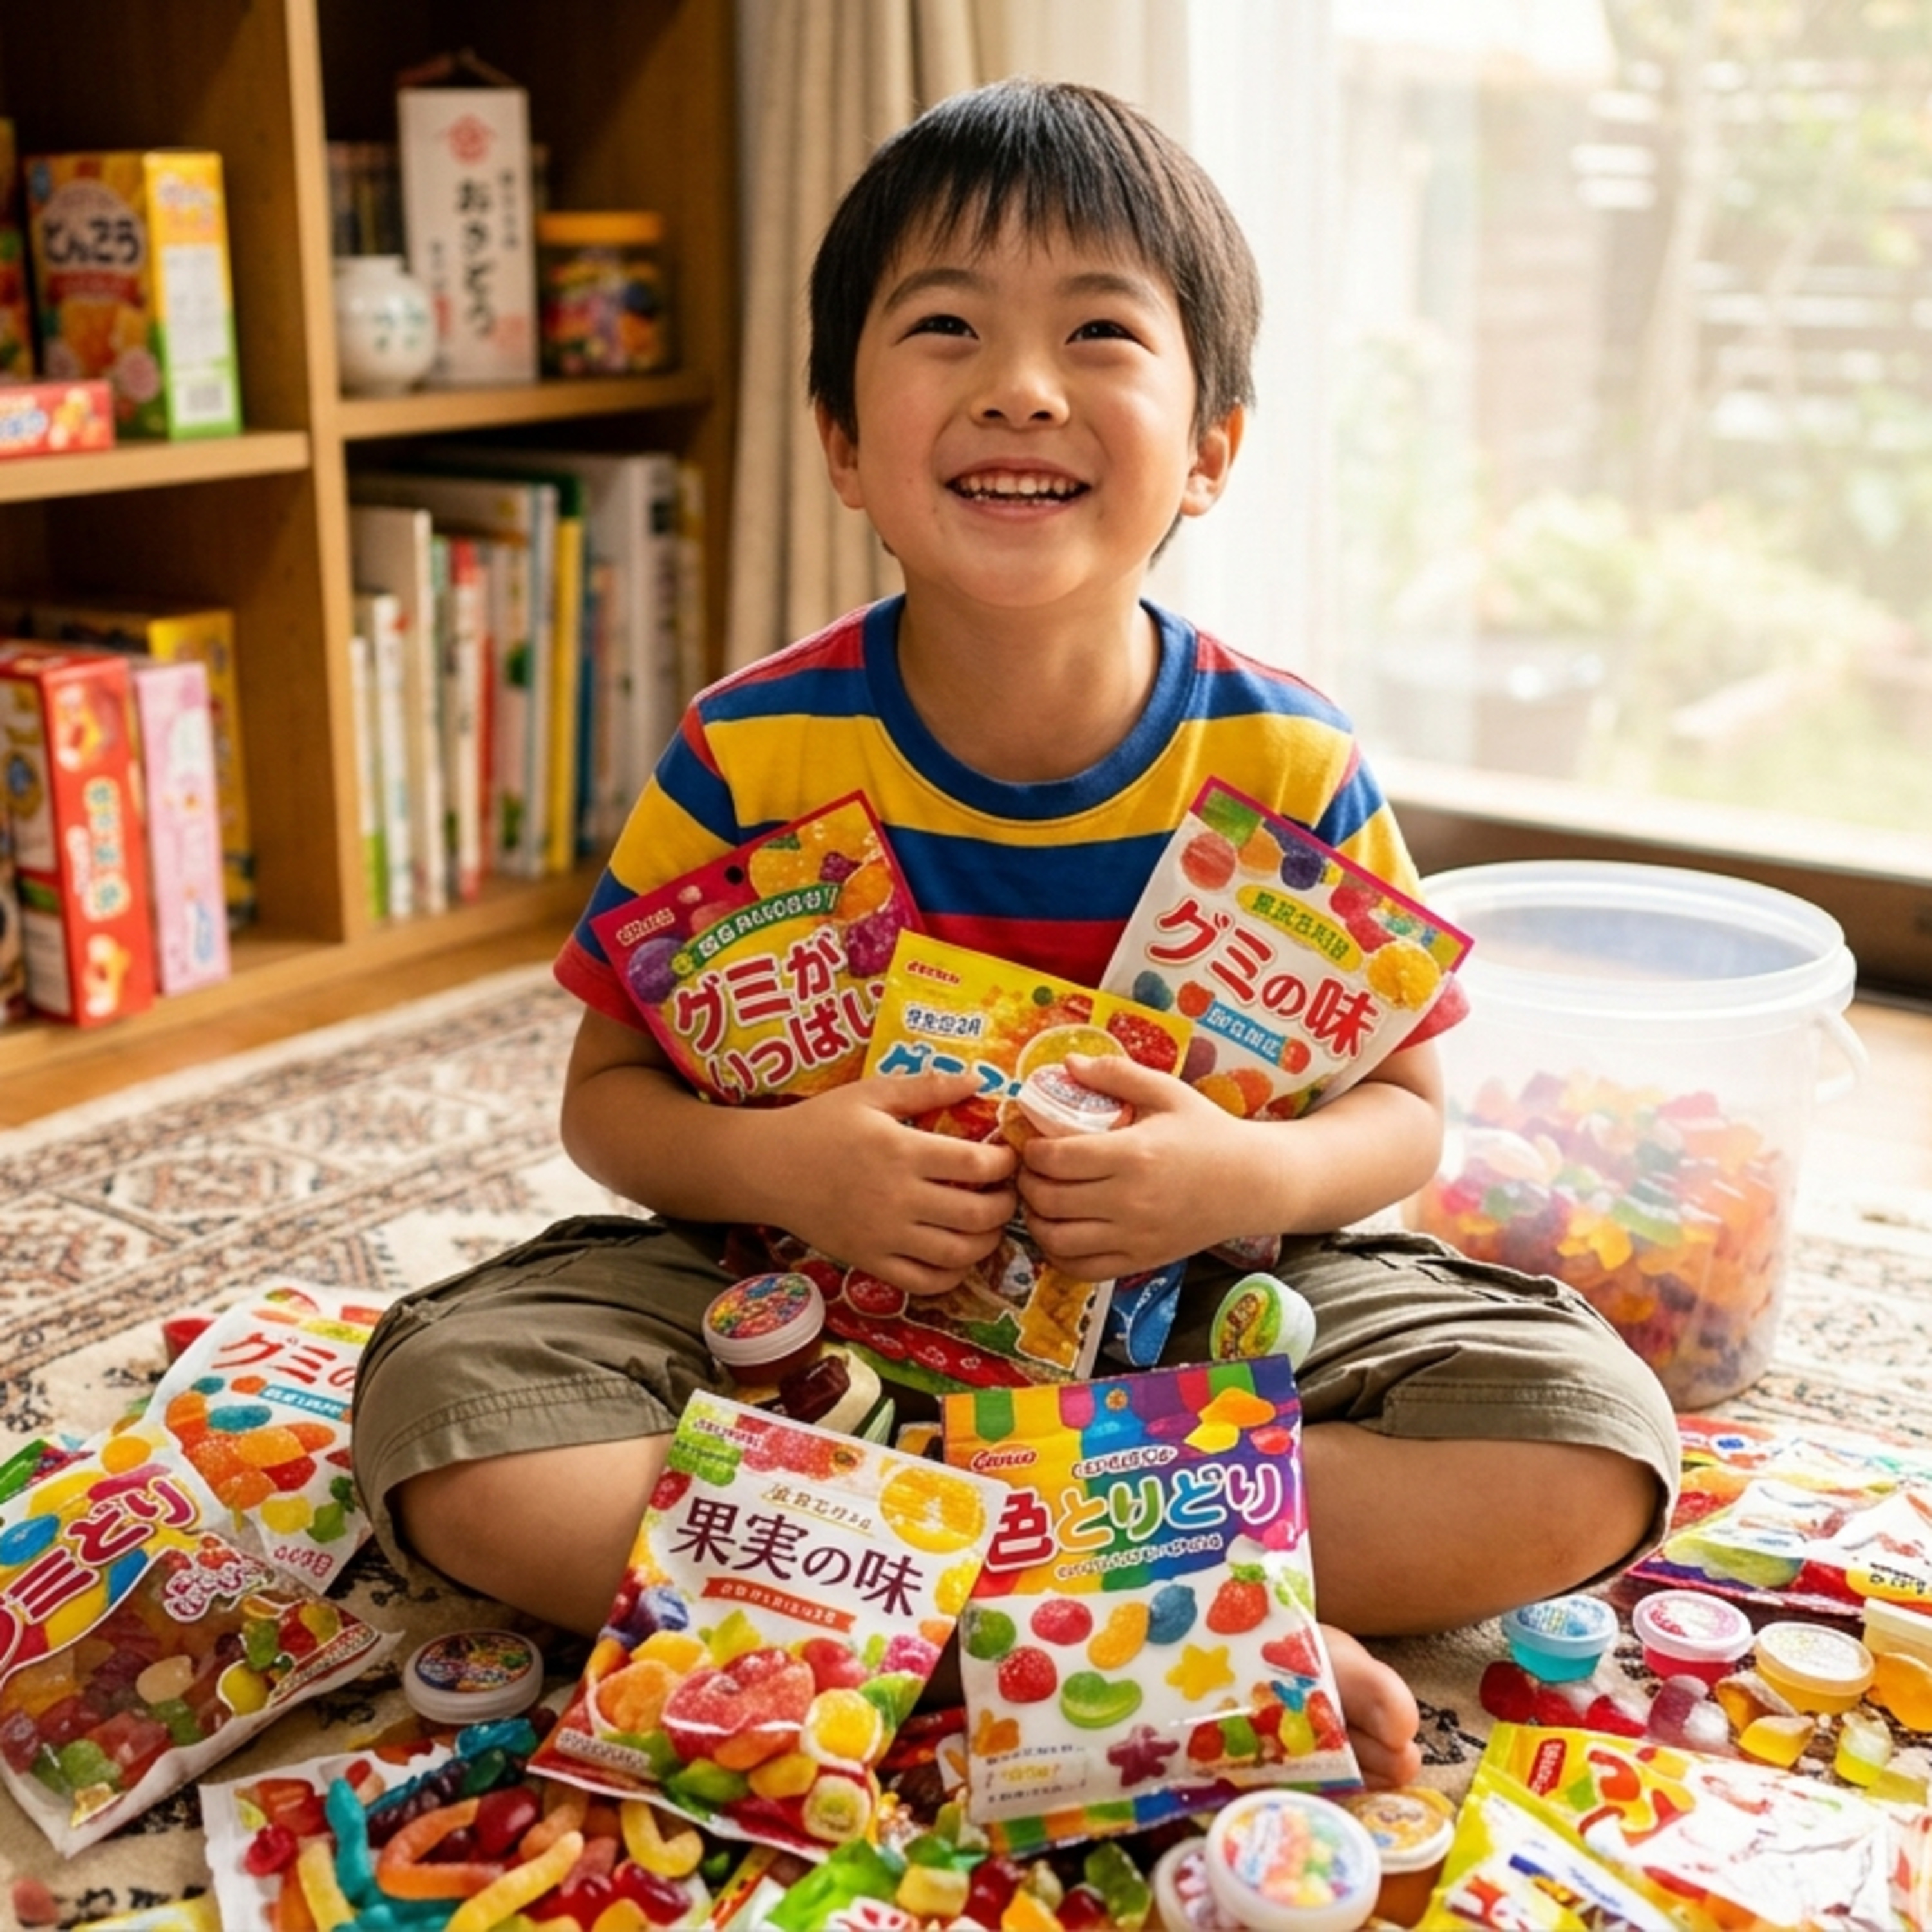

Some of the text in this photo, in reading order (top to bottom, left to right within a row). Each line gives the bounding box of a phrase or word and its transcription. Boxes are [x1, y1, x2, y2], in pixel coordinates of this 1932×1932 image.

[678, 931, 841, 1052] グミが
[1148, 900, 1378, 1057] グミの味
[670, 1496, 924, 1616] 果実の味
[987, 1467, 1280, 1566] 色とりどり
